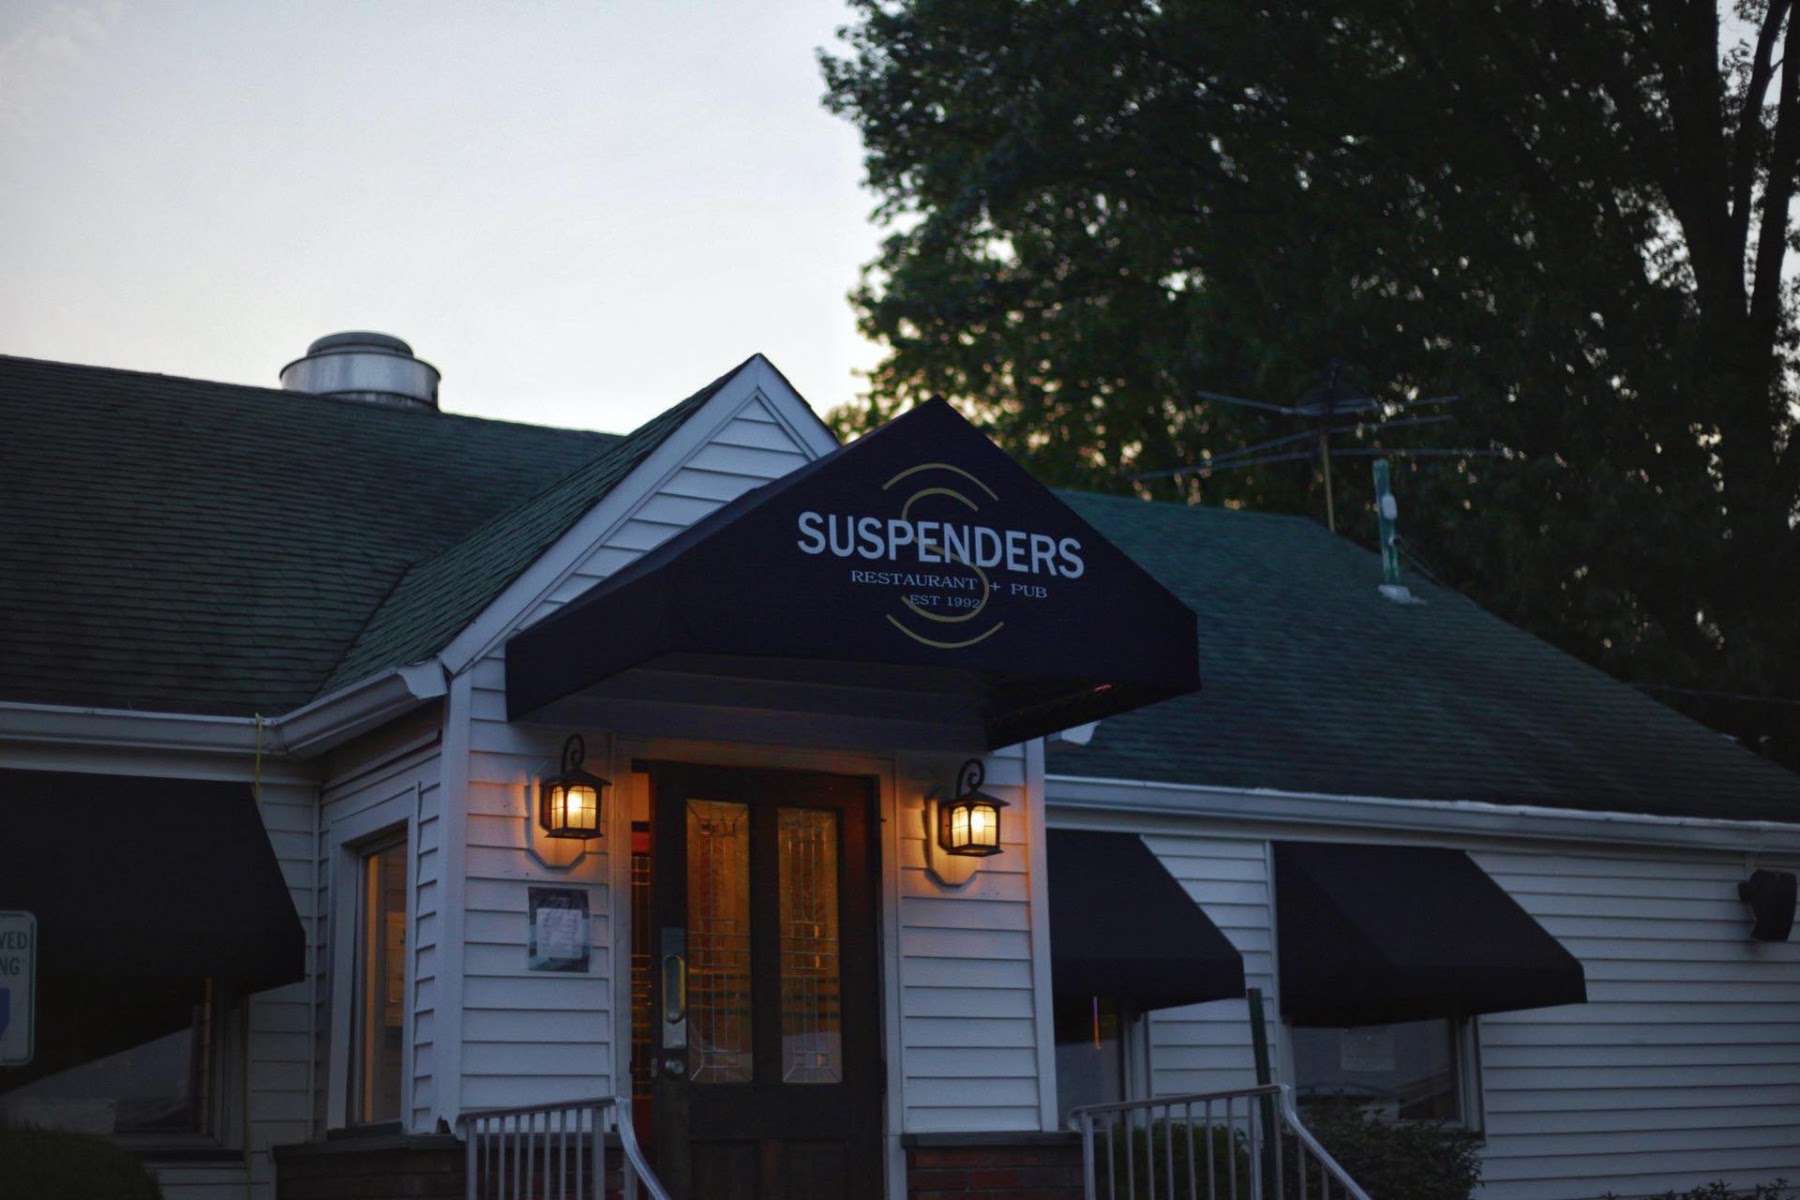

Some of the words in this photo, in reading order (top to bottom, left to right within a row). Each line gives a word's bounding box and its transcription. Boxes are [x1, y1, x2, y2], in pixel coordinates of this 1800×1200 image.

[797, 511, 1085, 579] SUSPENDERS
[851, 570, 978, 591] RESTAURANT
[990, 582, 1001, 592] +
[1011, 582, 1048, 599] PUB
[909, 594, 941, 607] EST
[947, 596, 980, 609] 1992
